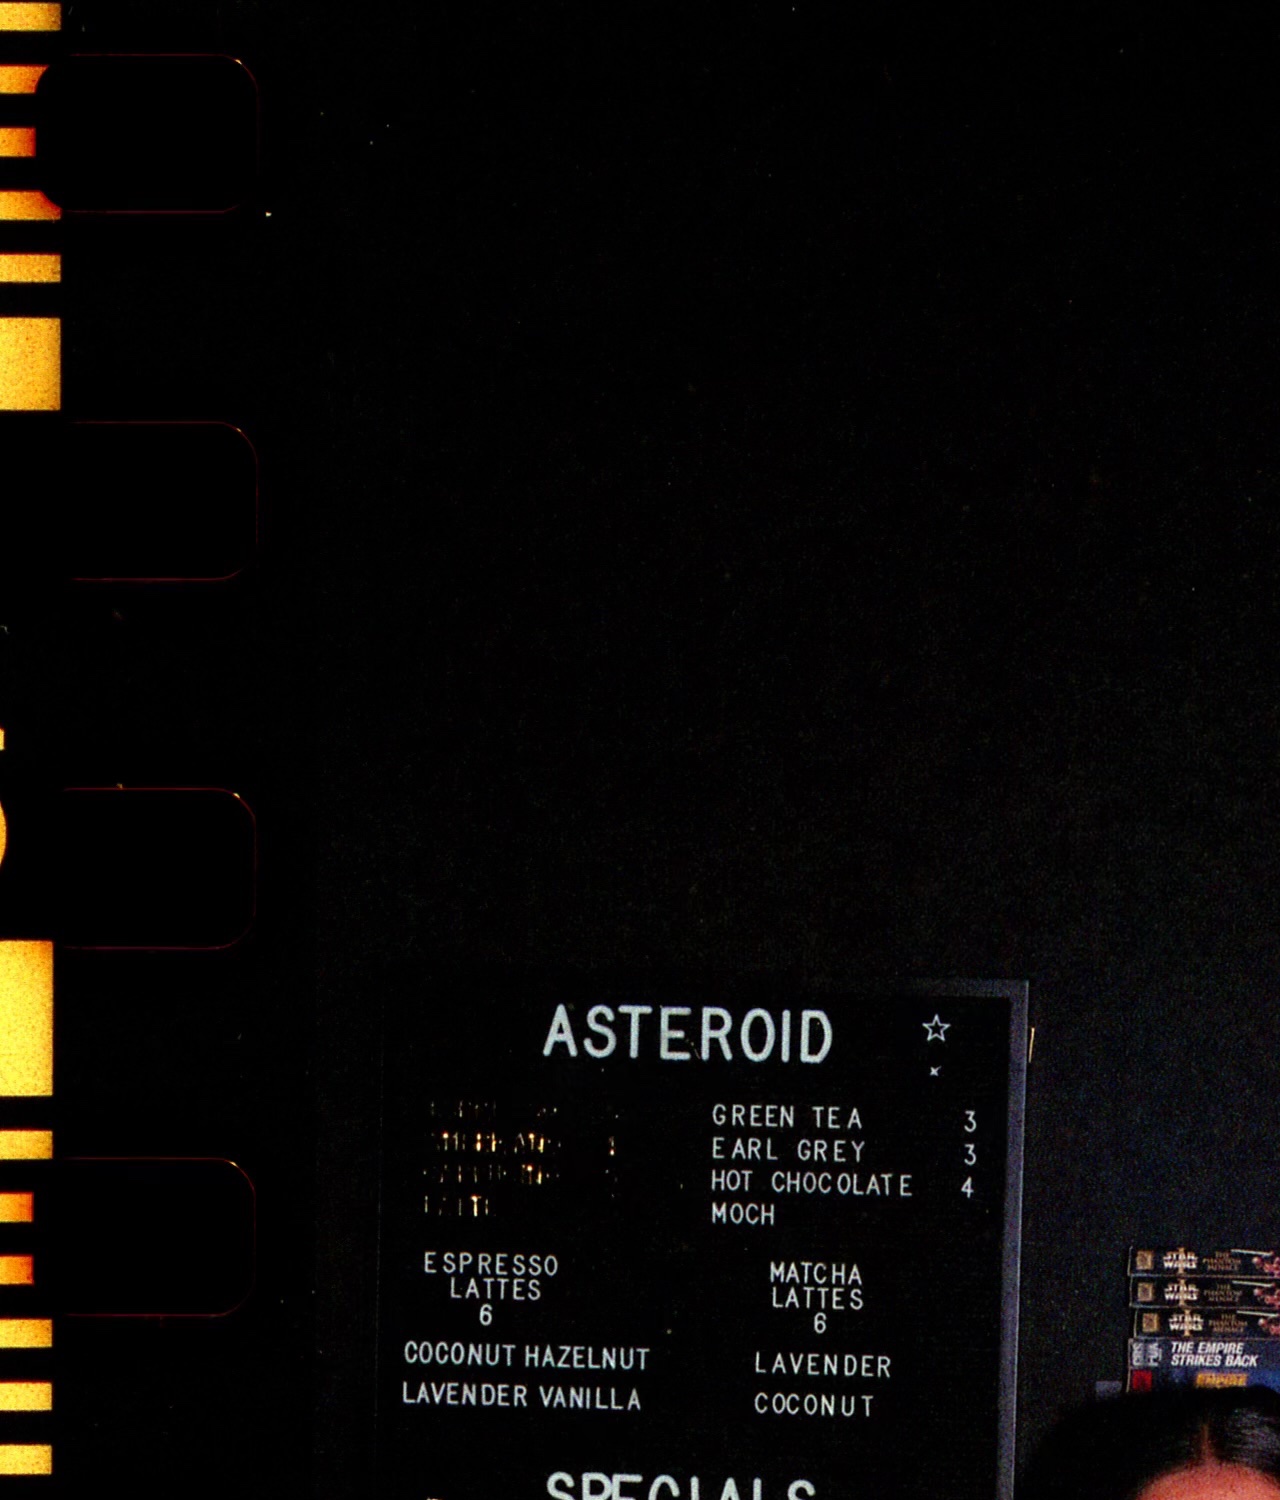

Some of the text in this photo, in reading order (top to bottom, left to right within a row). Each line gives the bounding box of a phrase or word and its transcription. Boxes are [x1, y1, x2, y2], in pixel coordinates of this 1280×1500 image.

[543, 1004, 832, 1063] ASTEROID
[713, 1104, 977, 1133] GREEN TEA 3
[713, 1137, 977, 1166] EARL GREY 3
[712, 1169, 974, 1199] HOT CHOCOLATE 4
[712, 1202, 775, 1226] MOCH
[425, 1252, 558, 1277] ESPRESSO
[771, 1262, 863, 1286] MATCHA
[451, 1279, 541, 1301] LATTES
[773, 1288, 864, 1311] LATTES
[479, 1303, 493, 1326] 6
[813, 1312, 827, 1334] 6
[405, 1341, 650, 1371] COCONUT HAZELNUT
[1171, 1341, 1196, 1354] THE
[1199, 1342, 1245, 1355] EMPIRE
[1171, 1354, 1222, 1367] STRIKES
[1225, 1354, 1259, 1367] BACK
[755, 1352, 891, 1378] LAVENDER
[403, 1381, 641, 1411] LAVENDER VANILLA
[755, 1392, 873, 1417] COCONUT
